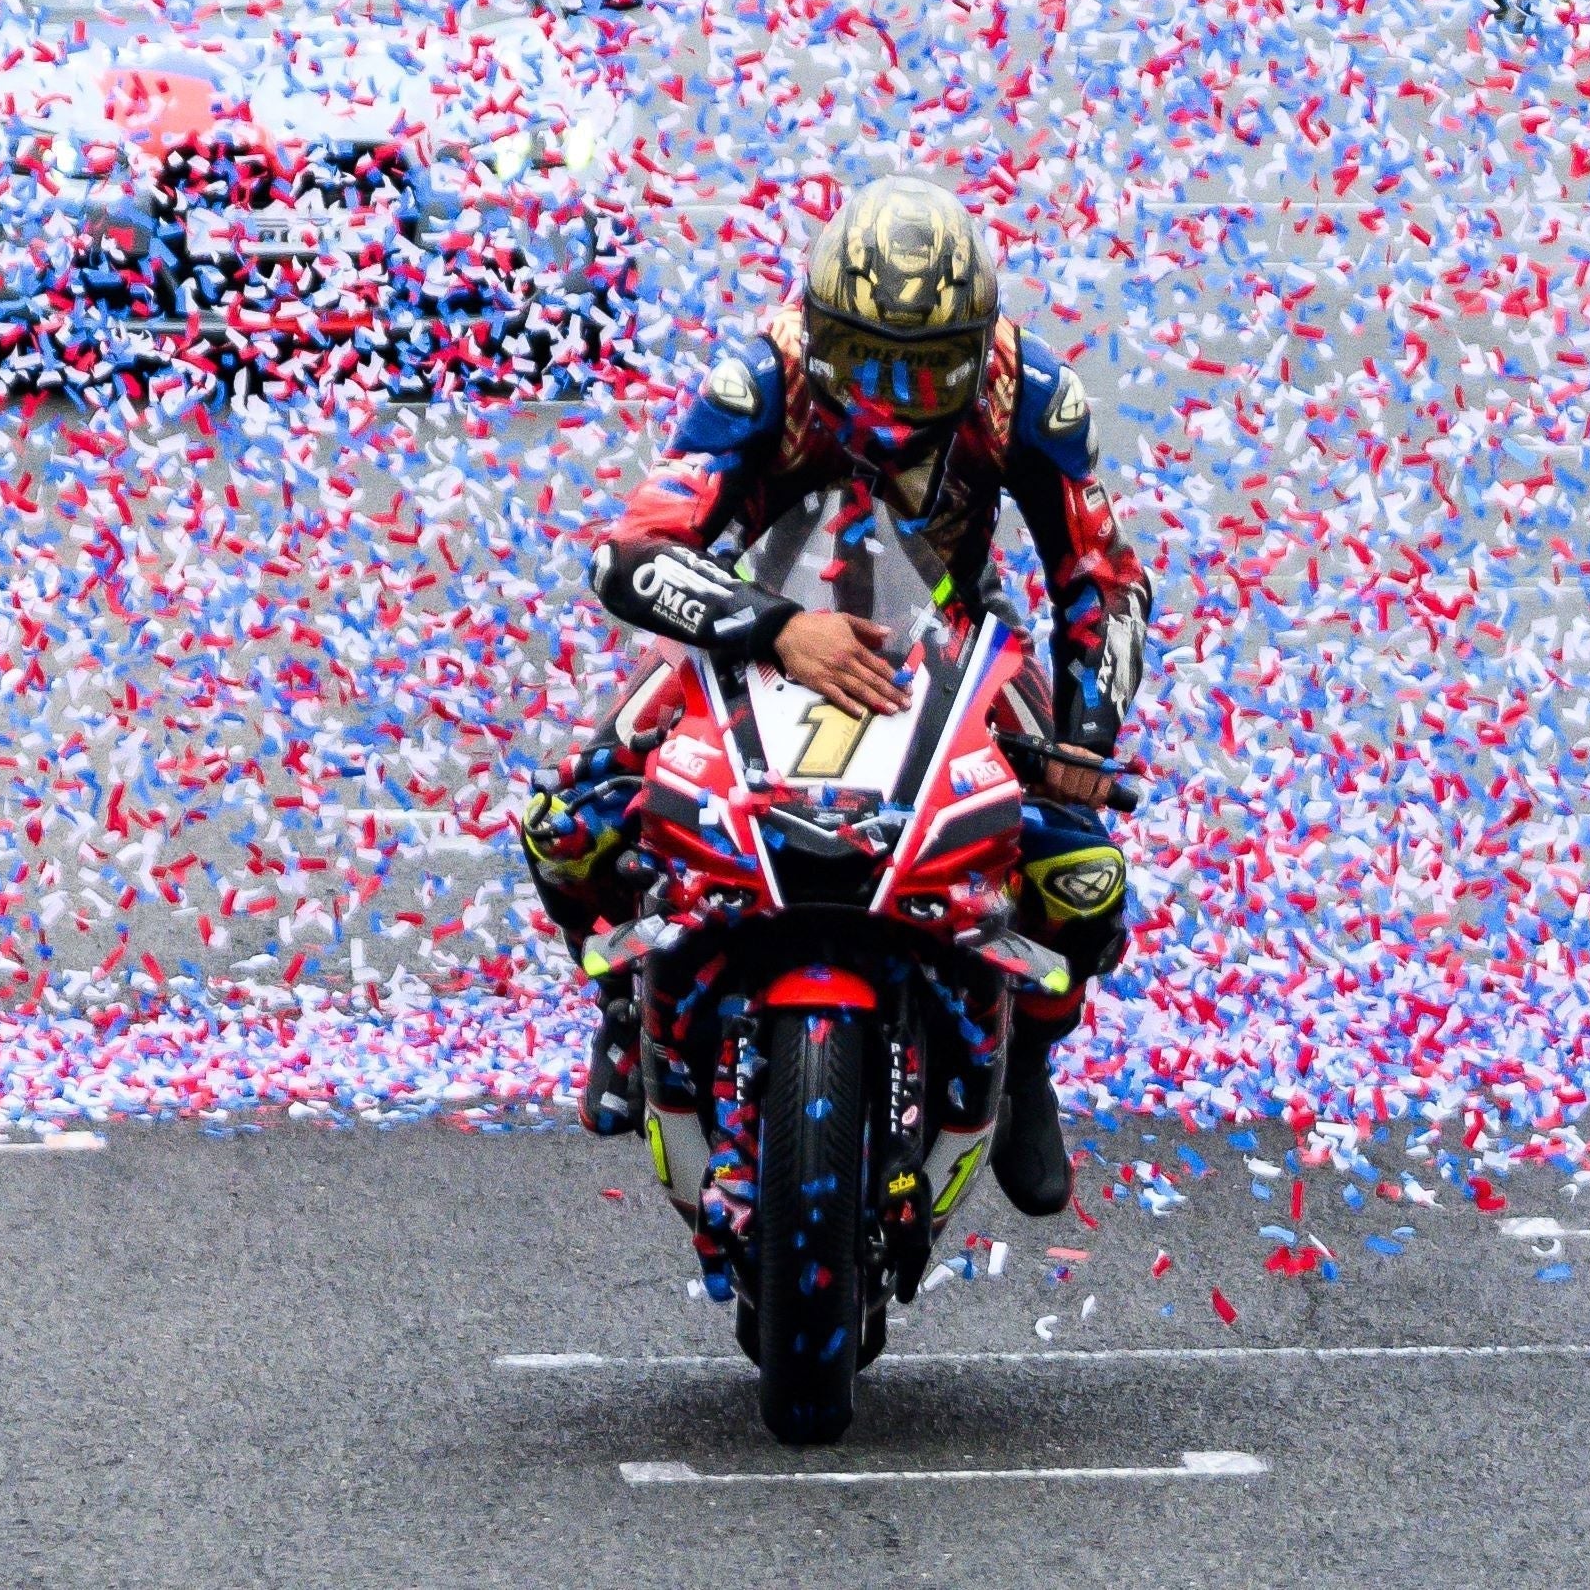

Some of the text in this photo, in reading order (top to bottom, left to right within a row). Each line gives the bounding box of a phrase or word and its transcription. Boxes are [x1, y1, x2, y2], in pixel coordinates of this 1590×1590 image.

[632, 562, 707, 625] OMG
[652, 603, 698, 635] RACING
[787, 696, 876, 779] 1
[890, 1042, 902, 1134] PIRELLI
